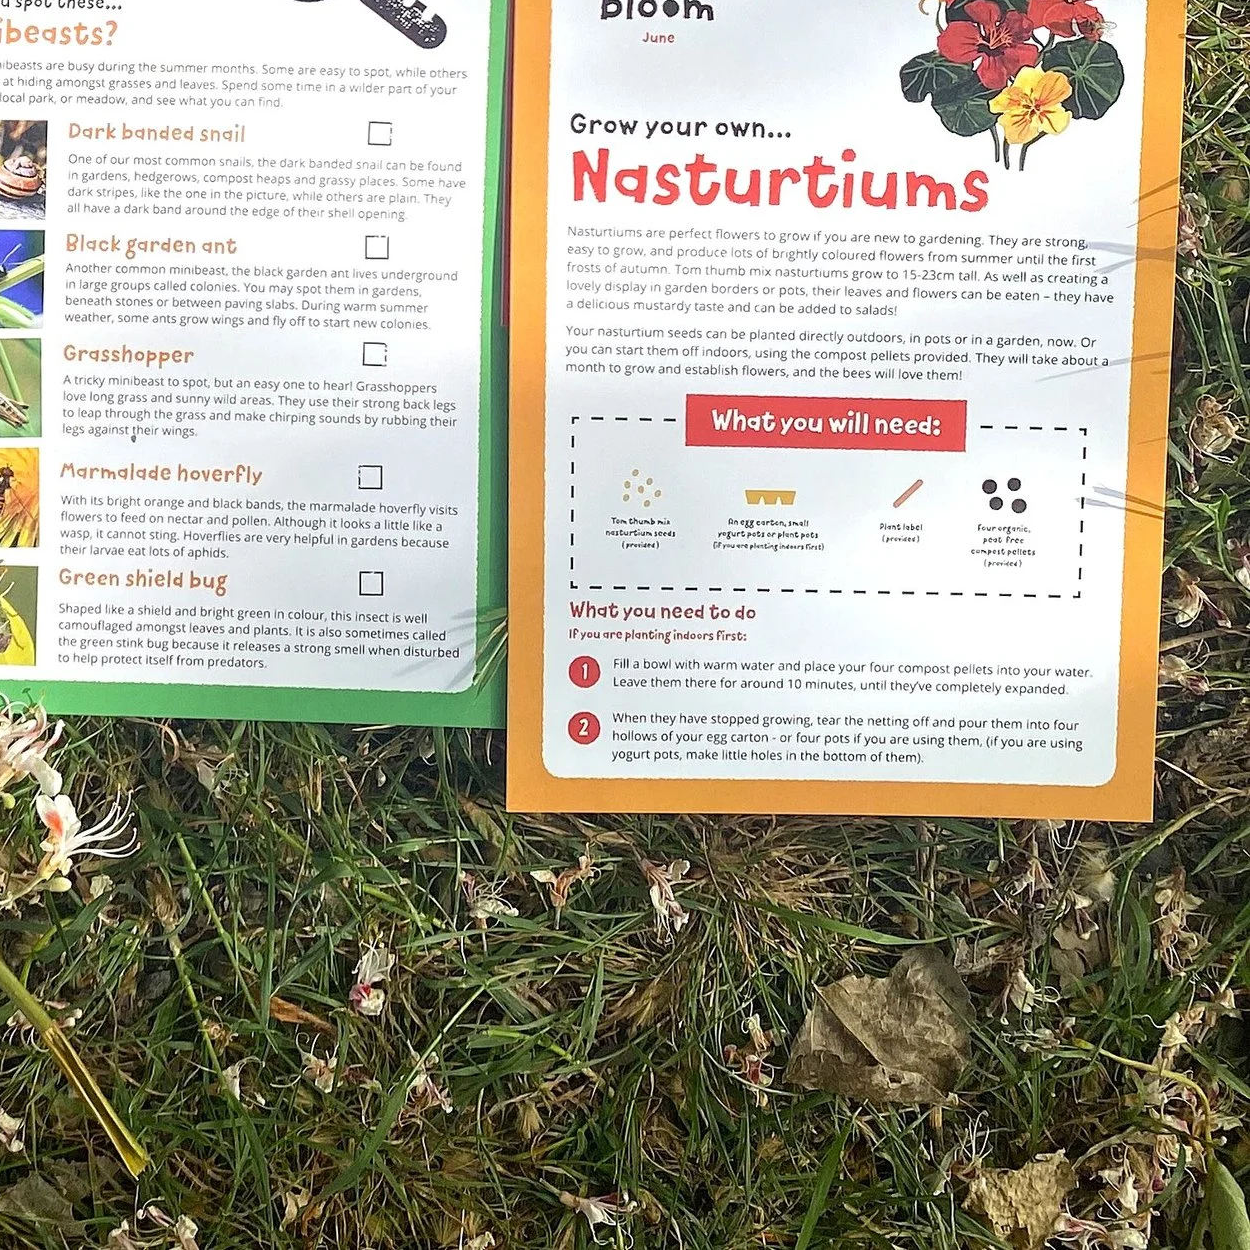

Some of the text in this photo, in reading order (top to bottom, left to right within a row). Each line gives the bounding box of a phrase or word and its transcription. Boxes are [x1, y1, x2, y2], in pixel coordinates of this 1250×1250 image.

[642, 32, 675, 43] June
[69, 122, 245, 142] Dark banded snail
[570, 113, 791, 139] Grow your own...
[572, 148, 989, 213] Nasturtiums
[66, 233, 237, 260] Black garden ant
[64, 344, 194, 369] Grasshopper
[566, 362, 962, 381] month to grow and establish flowers, and the bees will love them!
[711, 407, 942, 437] What you will need:
[60, 463, 262, 486] Marmalade hoverfly
[59, 568, 228, 597] Green shield bug
[570, 601, 756, 621] What you need to do
[569, 628, 747, 644] If you are planting indoors first:
[58, 653, 267, 669] to help protect itself from predators.
[581, 662, 589, 680] 1
[614, 658, 1093, 679] Fill a bowl with warm water and place your four compost pellets into your water.
[578, 717, 590, 737] 2
